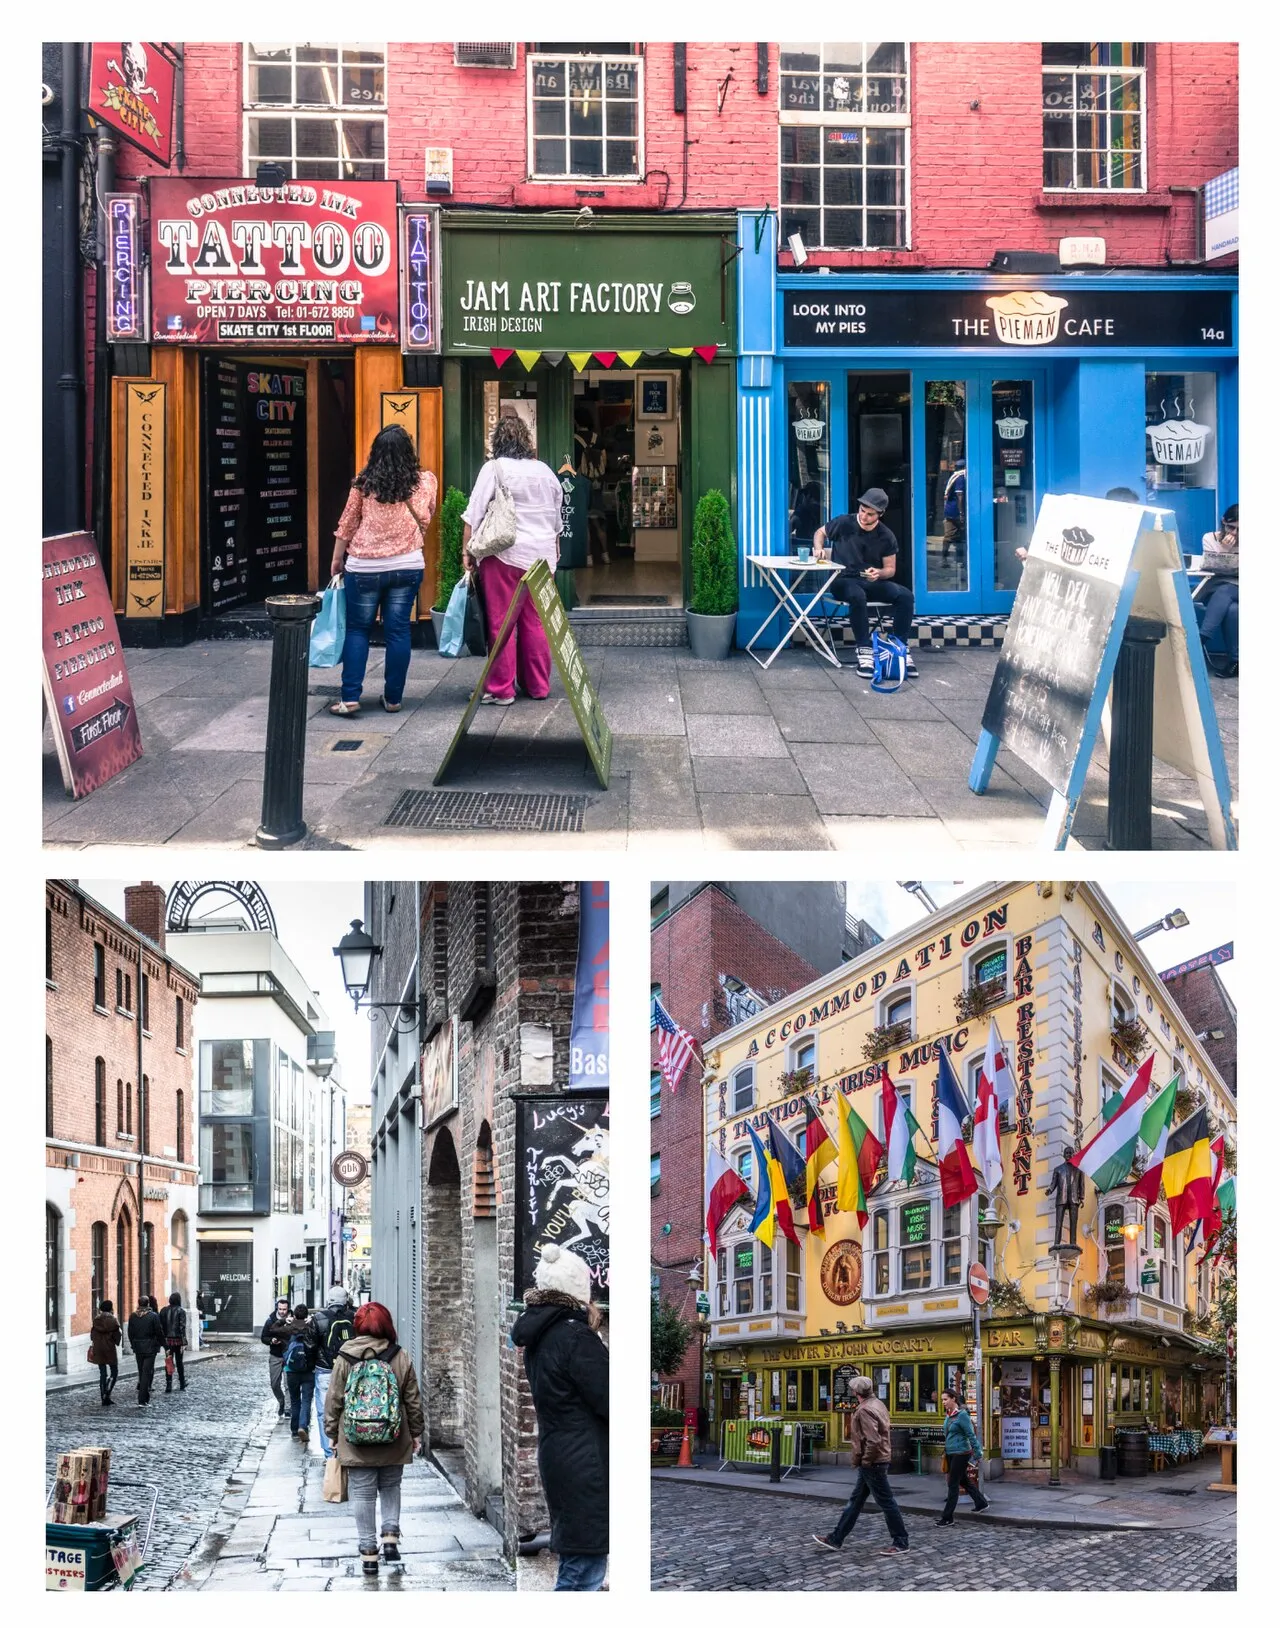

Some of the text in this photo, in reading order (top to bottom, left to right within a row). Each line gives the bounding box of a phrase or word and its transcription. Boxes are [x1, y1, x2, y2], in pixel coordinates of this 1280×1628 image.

[186, 184, 363, 220] CONNECTED INK
[158, 219, 391, 277] TATTOO
[114, 204, 135, 332] PIERCING
[410, 217, 429, 341] TATTOO
[184, 279, 364, 304] PIERCING
[460, 280, 663, 313] JAM ART FACTORY
[196, 305, 354, 318] OPEN 7 DAYS Tel: 01-672 8850
[793, 304, 865, 316] LOOK INTO
[220, 324, 333, 336] SKATE CITY 1st FLOOR
[463, 316, 543, 333] IRISH DESIGN
[816, 322, 865, 334] MY PIES
[952, 315, 1114, 340] THE PIEMAN CAFE
[1200, 328, 1225, 340] 14a
[248, 372, 305, 396] SKATE
[256, 399, 297, 421] CITY
[141, 413, 152, 500] CONNECTED
[1155, 441, 1202, 461] PIEMAN
[1046, 541, 1059, 554] THE
[1089, 554, 1110, 570] CAFE
[55, 579, 87, 606] INK
[53, 614, 105, 648] TATTOO
[54, 640, 117, 681] PIERCING
[77, 670, 124, 705] Connectedink
[746, 903, 1009, 1060] ACCOMMODATION
[571, 1047, 608, 1076] Bas
[898, 1027, 969, 1074] MUSIC
[1015, 934, 1036, 1197] BAR RESTAURANT
[533, 1104, 585, 1130] Lucy's
[341, 1163, 358, 1175] gbk
[906, 1223, 927, 1233] MUSIC
[909, 1233, 923, 1241] BAR
[220, 1274, 251, 1282] WELCOME
[762, 1350, 780, 1362] THE
[784, 1346, 821, 1361] OLIVER
[872, 1336, 936, 1355] GOGARTY
[987, 1330, 1025, 1348] BAR
[46, 1550, 82, 1564] TAGE
[46, 1567, 85, 1579] STAIRS
